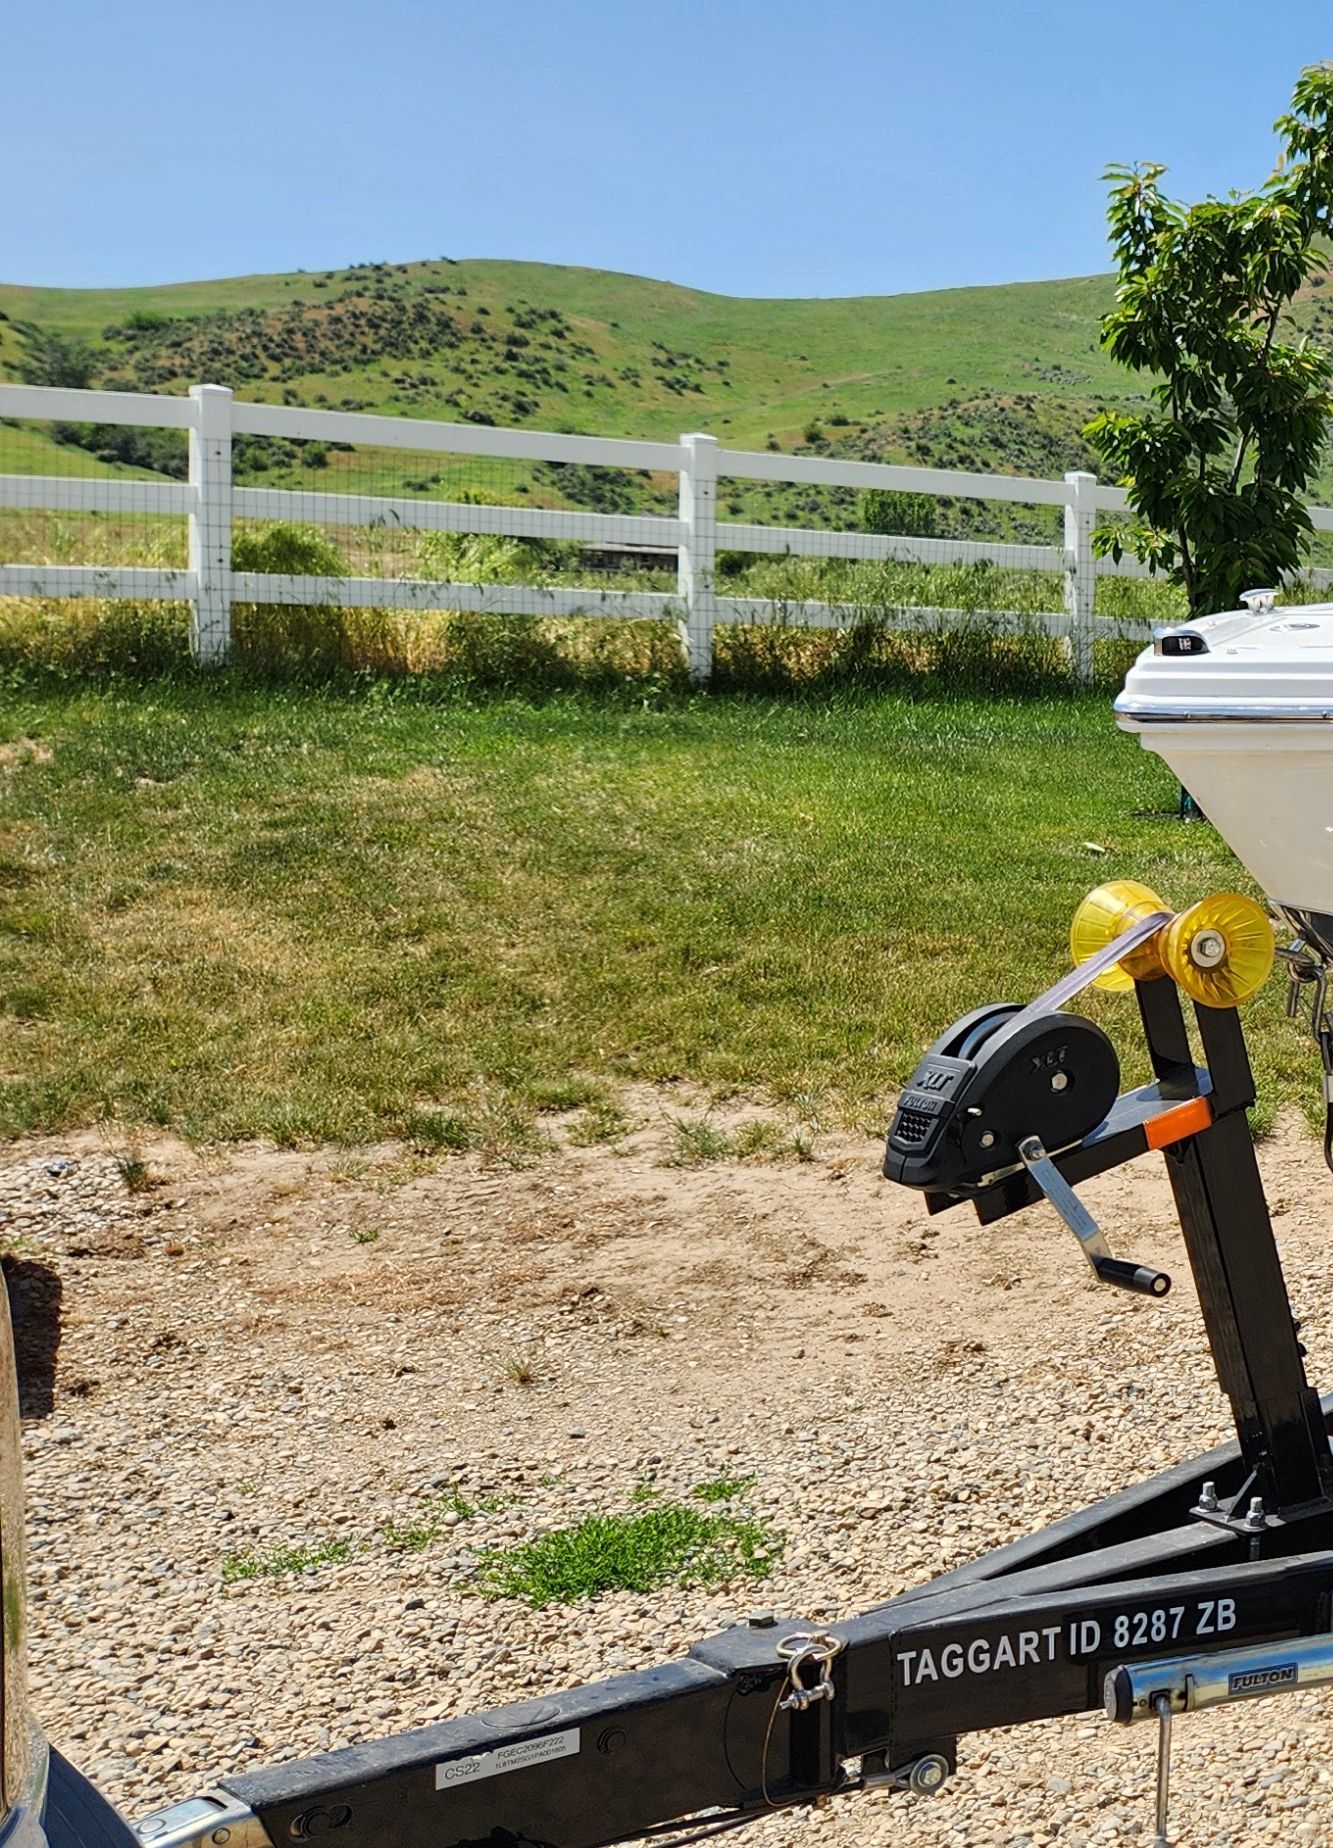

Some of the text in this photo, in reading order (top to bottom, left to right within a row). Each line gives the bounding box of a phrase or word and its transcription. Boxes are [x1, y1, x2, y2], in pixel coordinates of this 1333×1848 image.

[897, 1598, 1237, 1687] TAGGART ID 8287 ZB
[1231, 1666, 1295, 1690] FULTON
[444, 1761, 481, 1780] CS22
